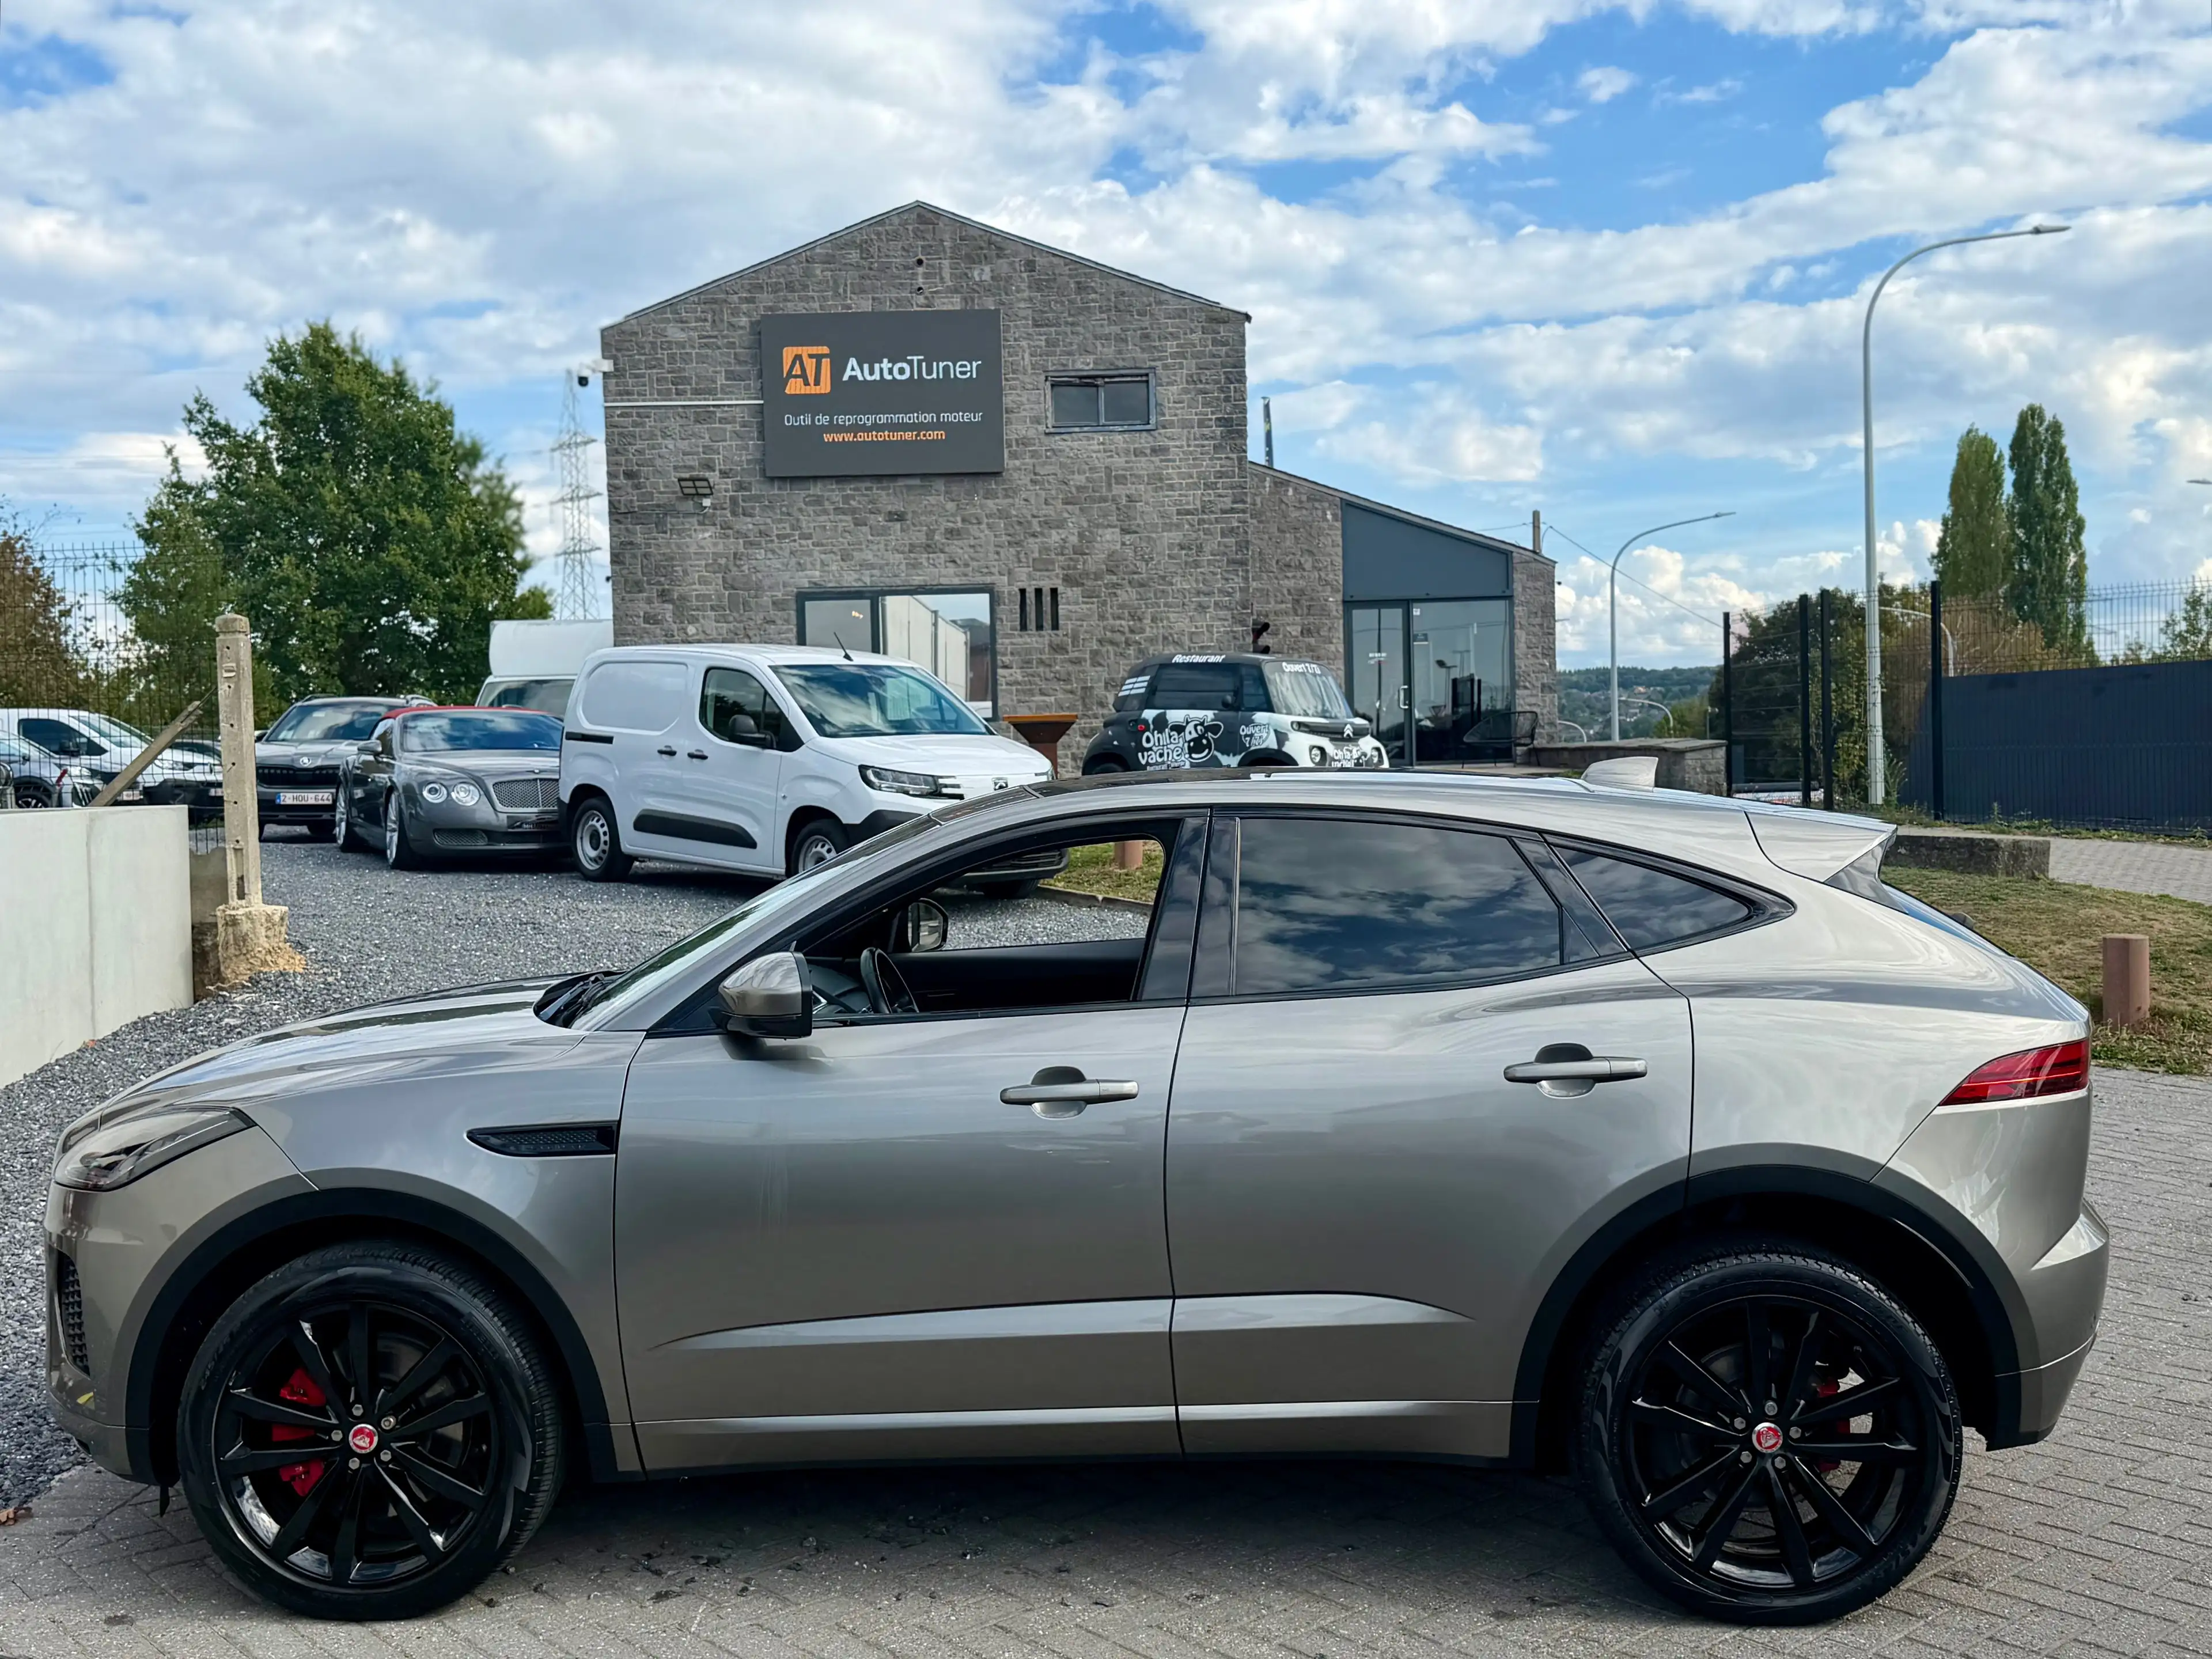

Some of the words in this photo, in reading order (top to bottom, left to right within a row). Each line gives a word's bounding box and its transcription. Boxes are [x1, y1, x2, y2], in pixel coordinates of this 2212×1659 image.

[784, 353, 830, 387] AT
[842, 355, 982, 381] AutoTuner
[785, 413, 811, 426] Outil
[815, 413, 830, 425] de
[834, 411, 937, 427] reprogrammation
[940, 411, 983, 423] moteur
[823, 430, 945, 442] www.autotuner.com
[1172, 654, 1226, 663] Restaurant
[1240, 724, 1268, 735] Ouvert
